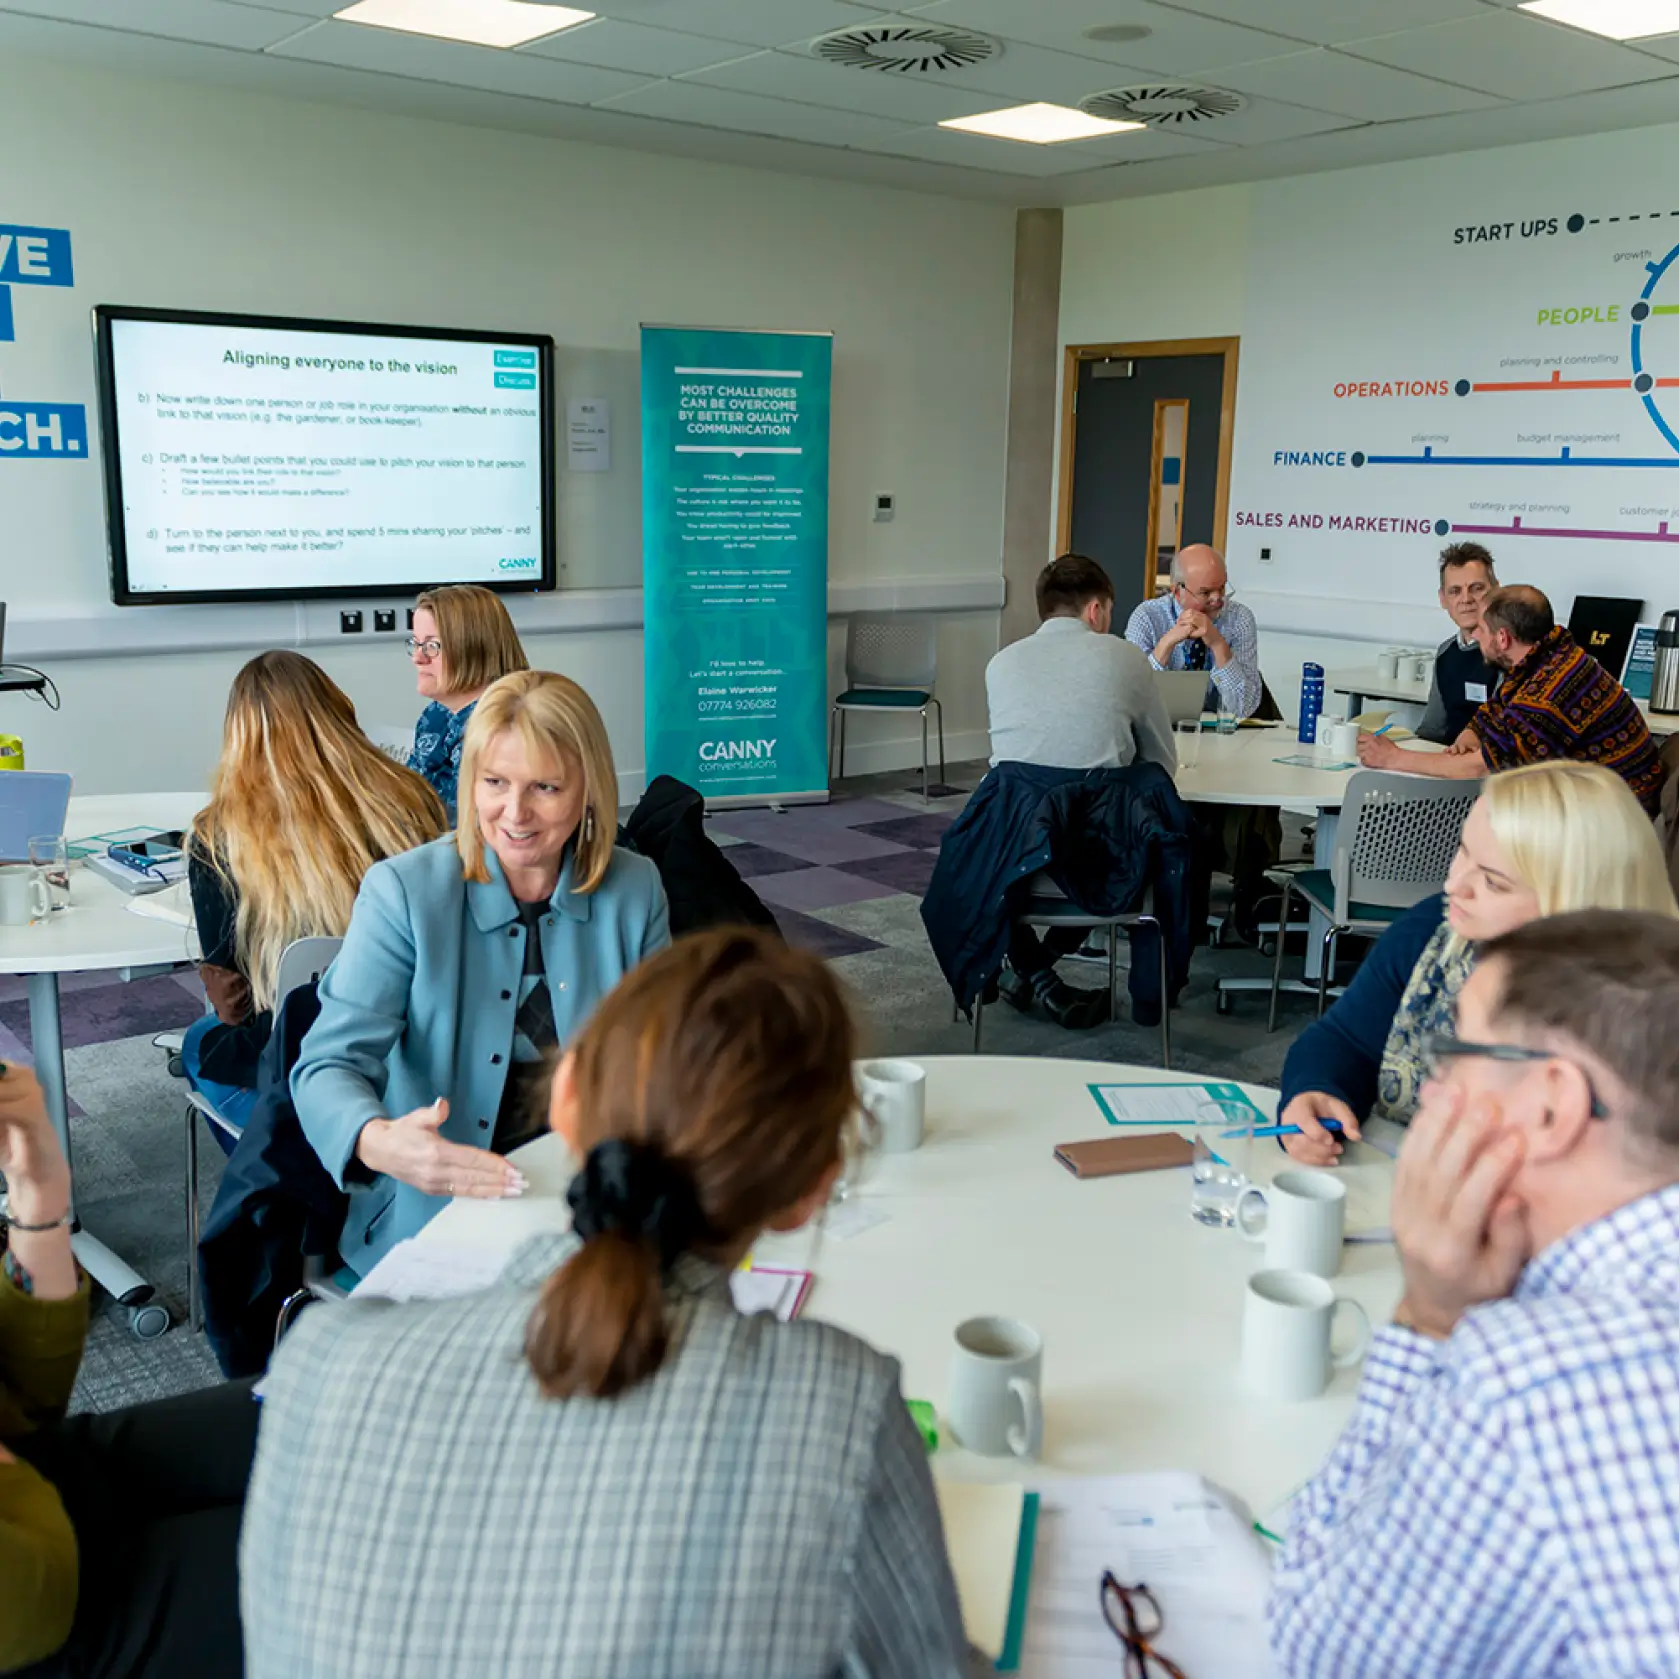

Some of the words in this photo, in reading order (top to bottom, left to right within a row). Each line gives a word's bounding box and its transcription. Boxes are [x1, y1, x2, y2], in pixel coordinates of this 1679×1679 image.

[1454, 222, 1514, 244] START
[1520, 218, 1558, 238] UPS
[1612, 250, 1651, 262] growth
[1537, 304, 1620, 326] PEOPLE
[222, 349, 290, 370] Aligning
[295, 355, 365, 372] everyone
[369, 358, 384, 372] to
[388, 359, 411, 373] the
[415, 360, 458, 375] vision
[1500, 357, 1541, 368] planning
[1543, 355, 1562, 365] and
[1563, 354, 1619, 366] controlling
[680, 385, 714, 397] MOST
[716, 386, 797, 398] CHALLENGES
[1333, 380, 1449, 398] OPERATIONS
[156, 393, 181, 404] Now
[186, 394, 211, 404] write
[214, 395, 242, 406] down
[268, 399, 303, 410] person
[451, 404, 488, 416] without
[681, 398, 706, 409] CAN
[710, 399, 726, 410] BE
[729, 399, 797, 411] OVERCOME
[192, 409, 213, 420] that
[216, 411, 247, 421] vision
[678, 410, 693, 421] BY
[697, 411, 744, 422] BETTER
[746, 412, 800, 424] QUALITY
[687, 423, 791, 435] COMMUNICATION
[1411, 433, 1449, 443] planning
[1516, 433, 1551, 443] budget
[1553, 433, 1620, 443] management
[159, 453, 187, 464] Draft
[199, 453, 219, 464] few
[253, 455, 285, 467] points
[287, 455, 307, 466] that
[310, 457, 327, 467] you
[330, 456, 356, 466] could
[390, 457, 413, 468] pitch
[415, 459, 435, 468] your
[437, 458, 465, 467] vision
[477, 458, 494, 468] that
[1273, 451, 1346, 466] FINANCE
[1469, 501, 1505, 512] strategy
[1509, 502, 1526, 512] and
[1528, 503, 1570, 514] planning
[1619, 506, 1668, 516] customer
[1236, 511, 1283, 527] SALES
[1288, 514, 1323, 529] AND
[1328, 516, 1431, 534] MARKETING
[165, 528, 189, 539] Turn
[193, 528, 203, 538] to
[206, 528, 223, 538] the
[226, 529, 262, 541] person
[290, 528, 299, 538] to
[326, 527, 344, 537] and
[347, 526, 376, 539] spend
[412, 526, 445, 539] sharing
[447, 527, 467, 538] your
[515, 526, 532, 536] and
[197, 543, 220, 555] they
[271, 542, 299, 551] make
[498, 557, 536, 569] CANNY
[698, 687, 727, 695] Elaine
[729, 686, 777, 695] Warwicker
[698, 701, 733, 712] 07774
[735, 699, 777, 710] 926082
[699, 739, 777, 761] CANNY
[699, 759, 777, 773] conversations
